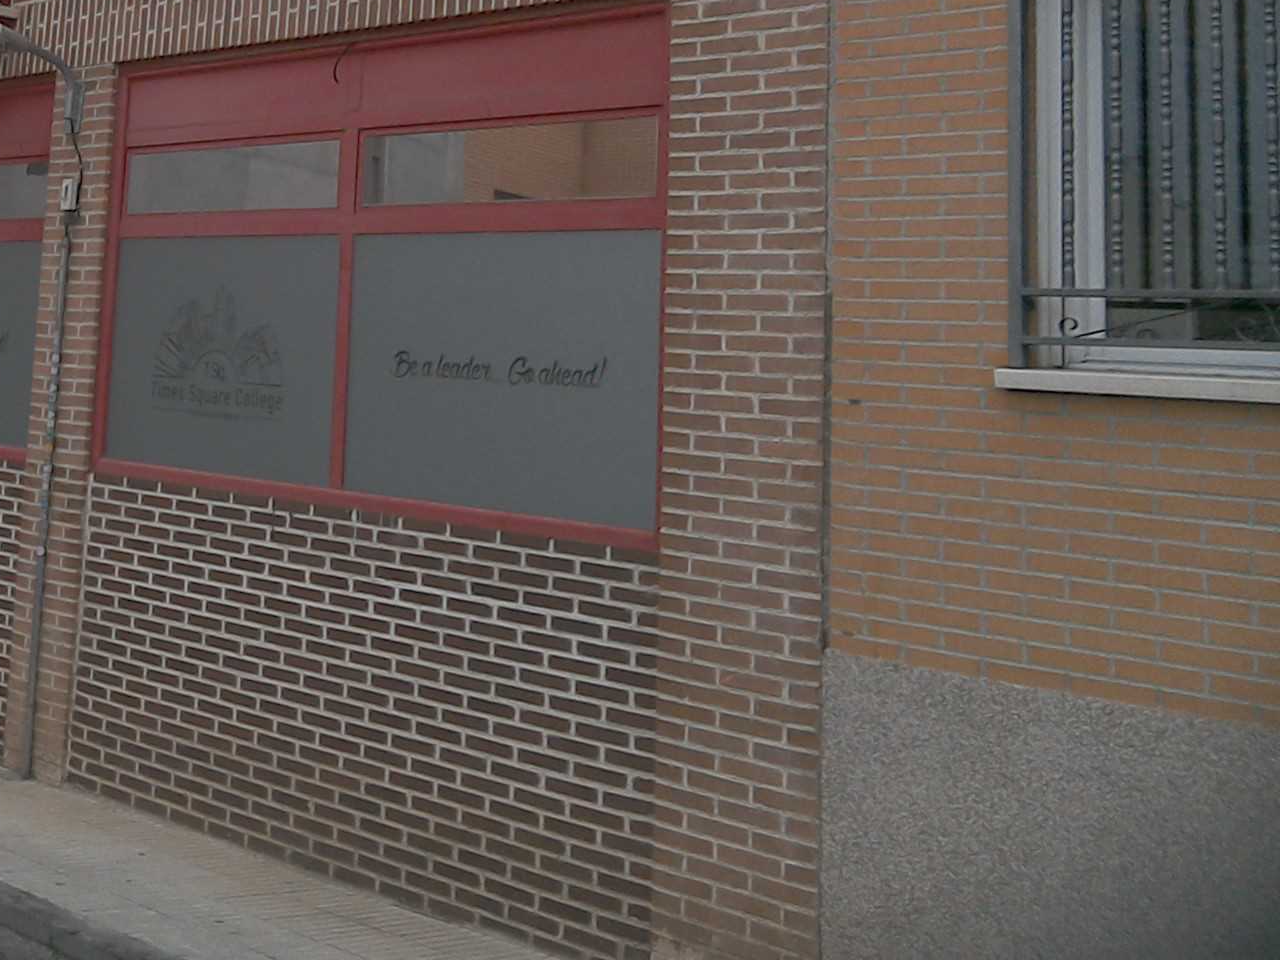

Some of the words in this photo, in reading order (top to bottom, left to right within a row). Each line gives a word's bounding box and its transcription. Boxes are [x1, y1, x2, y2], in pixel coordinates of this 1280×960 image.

[394, 350, 417, 378] Be
[422, 360, 432, 377] a
[508, 356, 536, 386] Go
[538, 356, 609, 387] ahead!
[189, 384, 232, 408] Square
[235, 388, 284, 415] College
